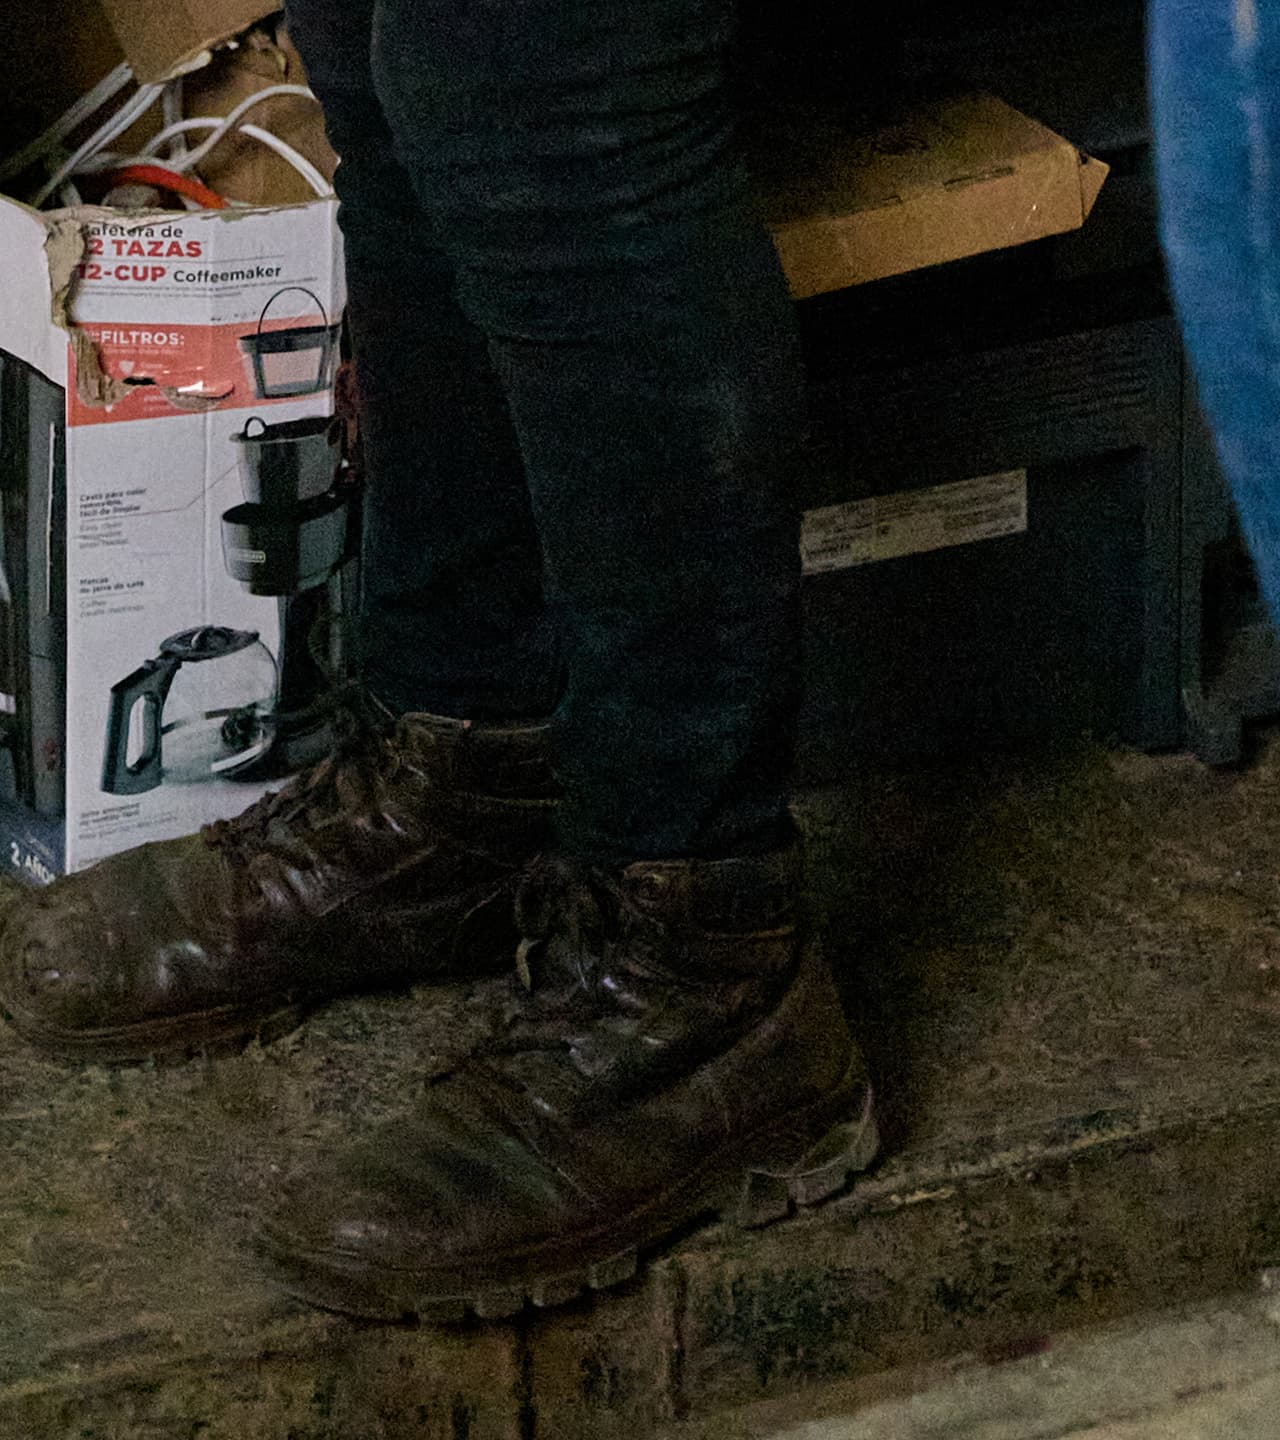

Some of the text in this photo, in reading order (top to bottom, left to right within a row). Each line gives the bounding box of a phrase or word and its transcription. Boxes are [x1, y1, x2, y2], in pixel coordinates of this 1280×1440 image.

[111, 239, 202, 258] TAZAS
[78, 263, 282, 284] 12-CUP Coffeemaker
[101, 330, 185, 346] FILTROS:
[10, 841, 21, 868] 2
